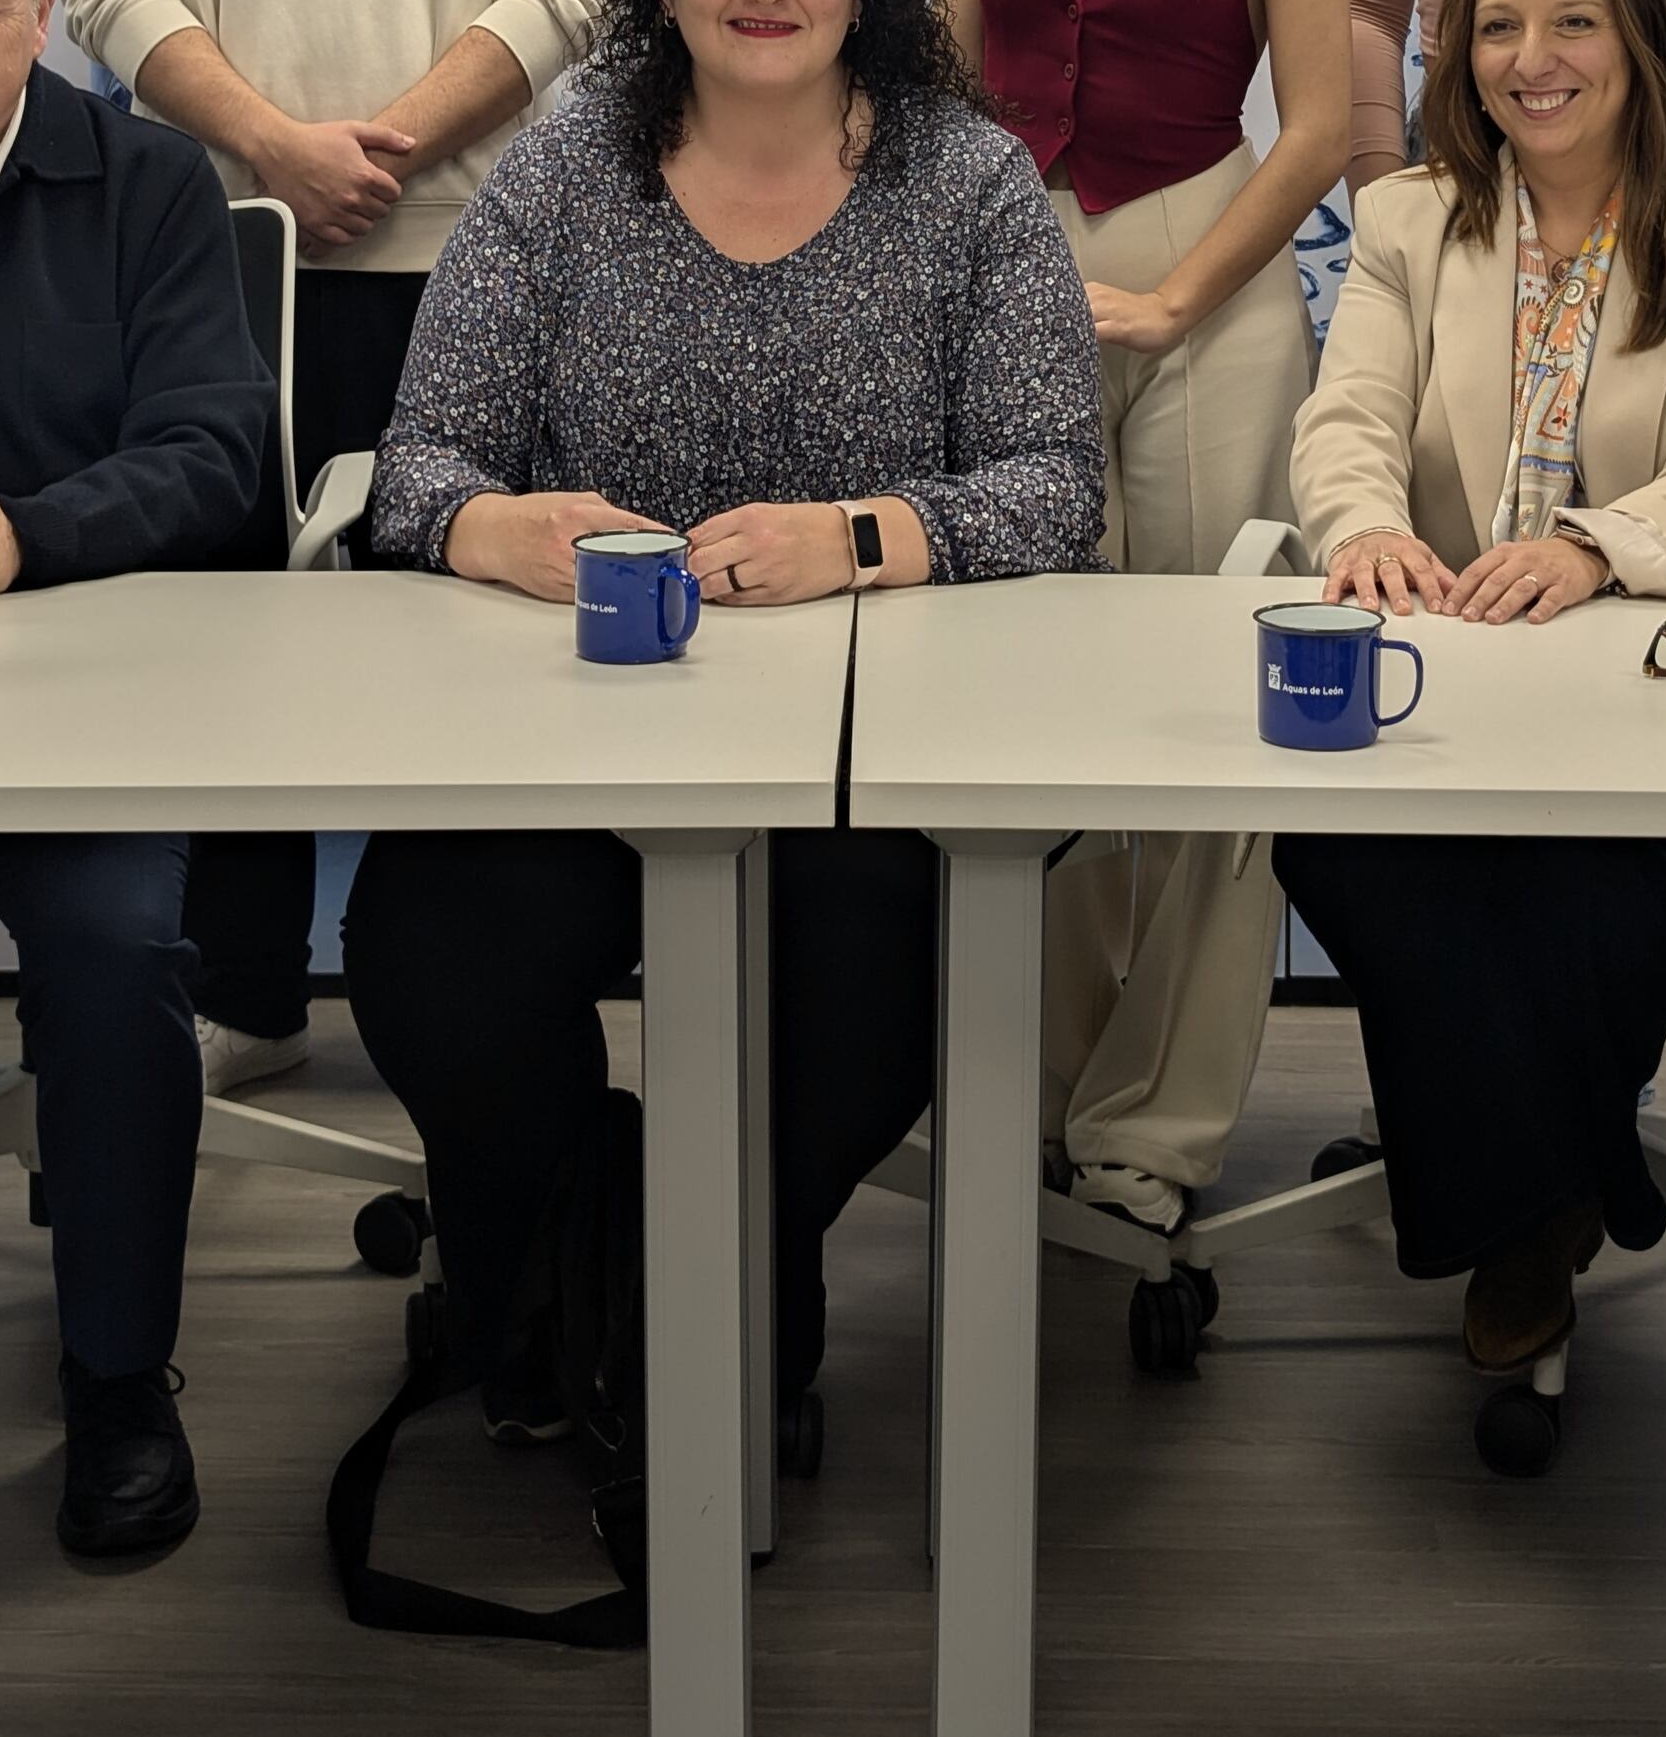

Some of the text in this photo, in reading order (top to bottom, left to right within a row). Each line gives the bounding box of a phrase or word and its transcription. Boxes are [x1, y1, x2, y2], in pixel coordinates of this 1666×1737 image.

[599, 604, 618, 614] León
[1282, 683, 1344, 696] Aguas de León
